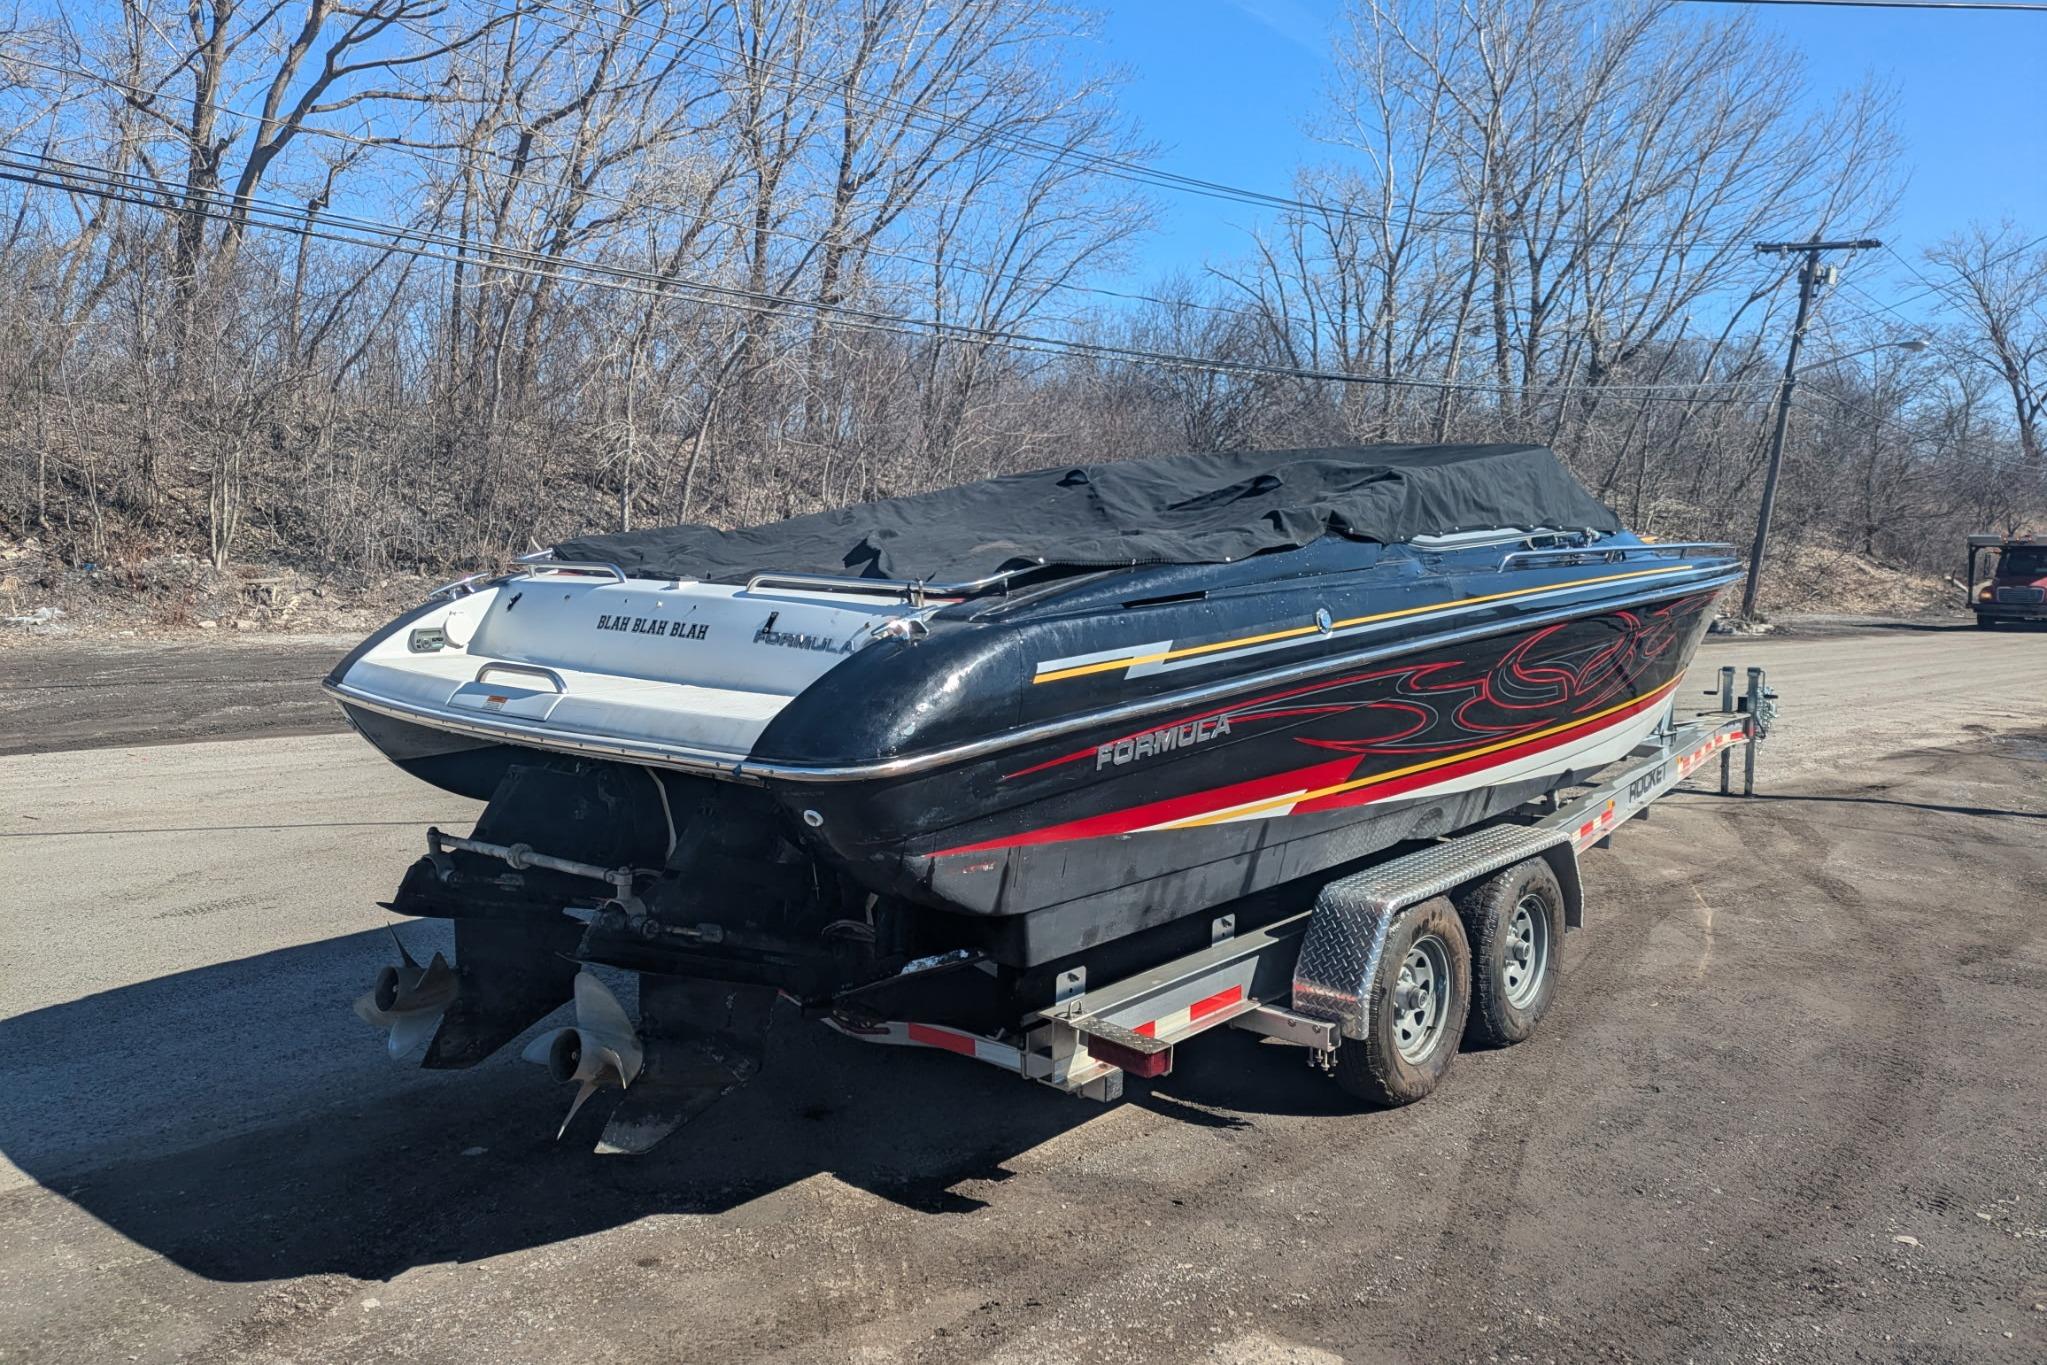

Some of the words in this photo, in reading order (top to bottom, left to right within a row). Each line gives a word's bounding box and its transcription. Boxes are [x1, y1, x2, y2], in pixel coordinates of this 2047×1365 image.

[597, 615, 631, 632] BLAH
[631, 618, 669, 636] BLAH
[669, 621, 710, 640] BLAH
[753, 629, 855, 654] FORMULA
[1096, 713, 1232, 771] FORMULA
[1628, 762, 1667, 803] ROCKET
